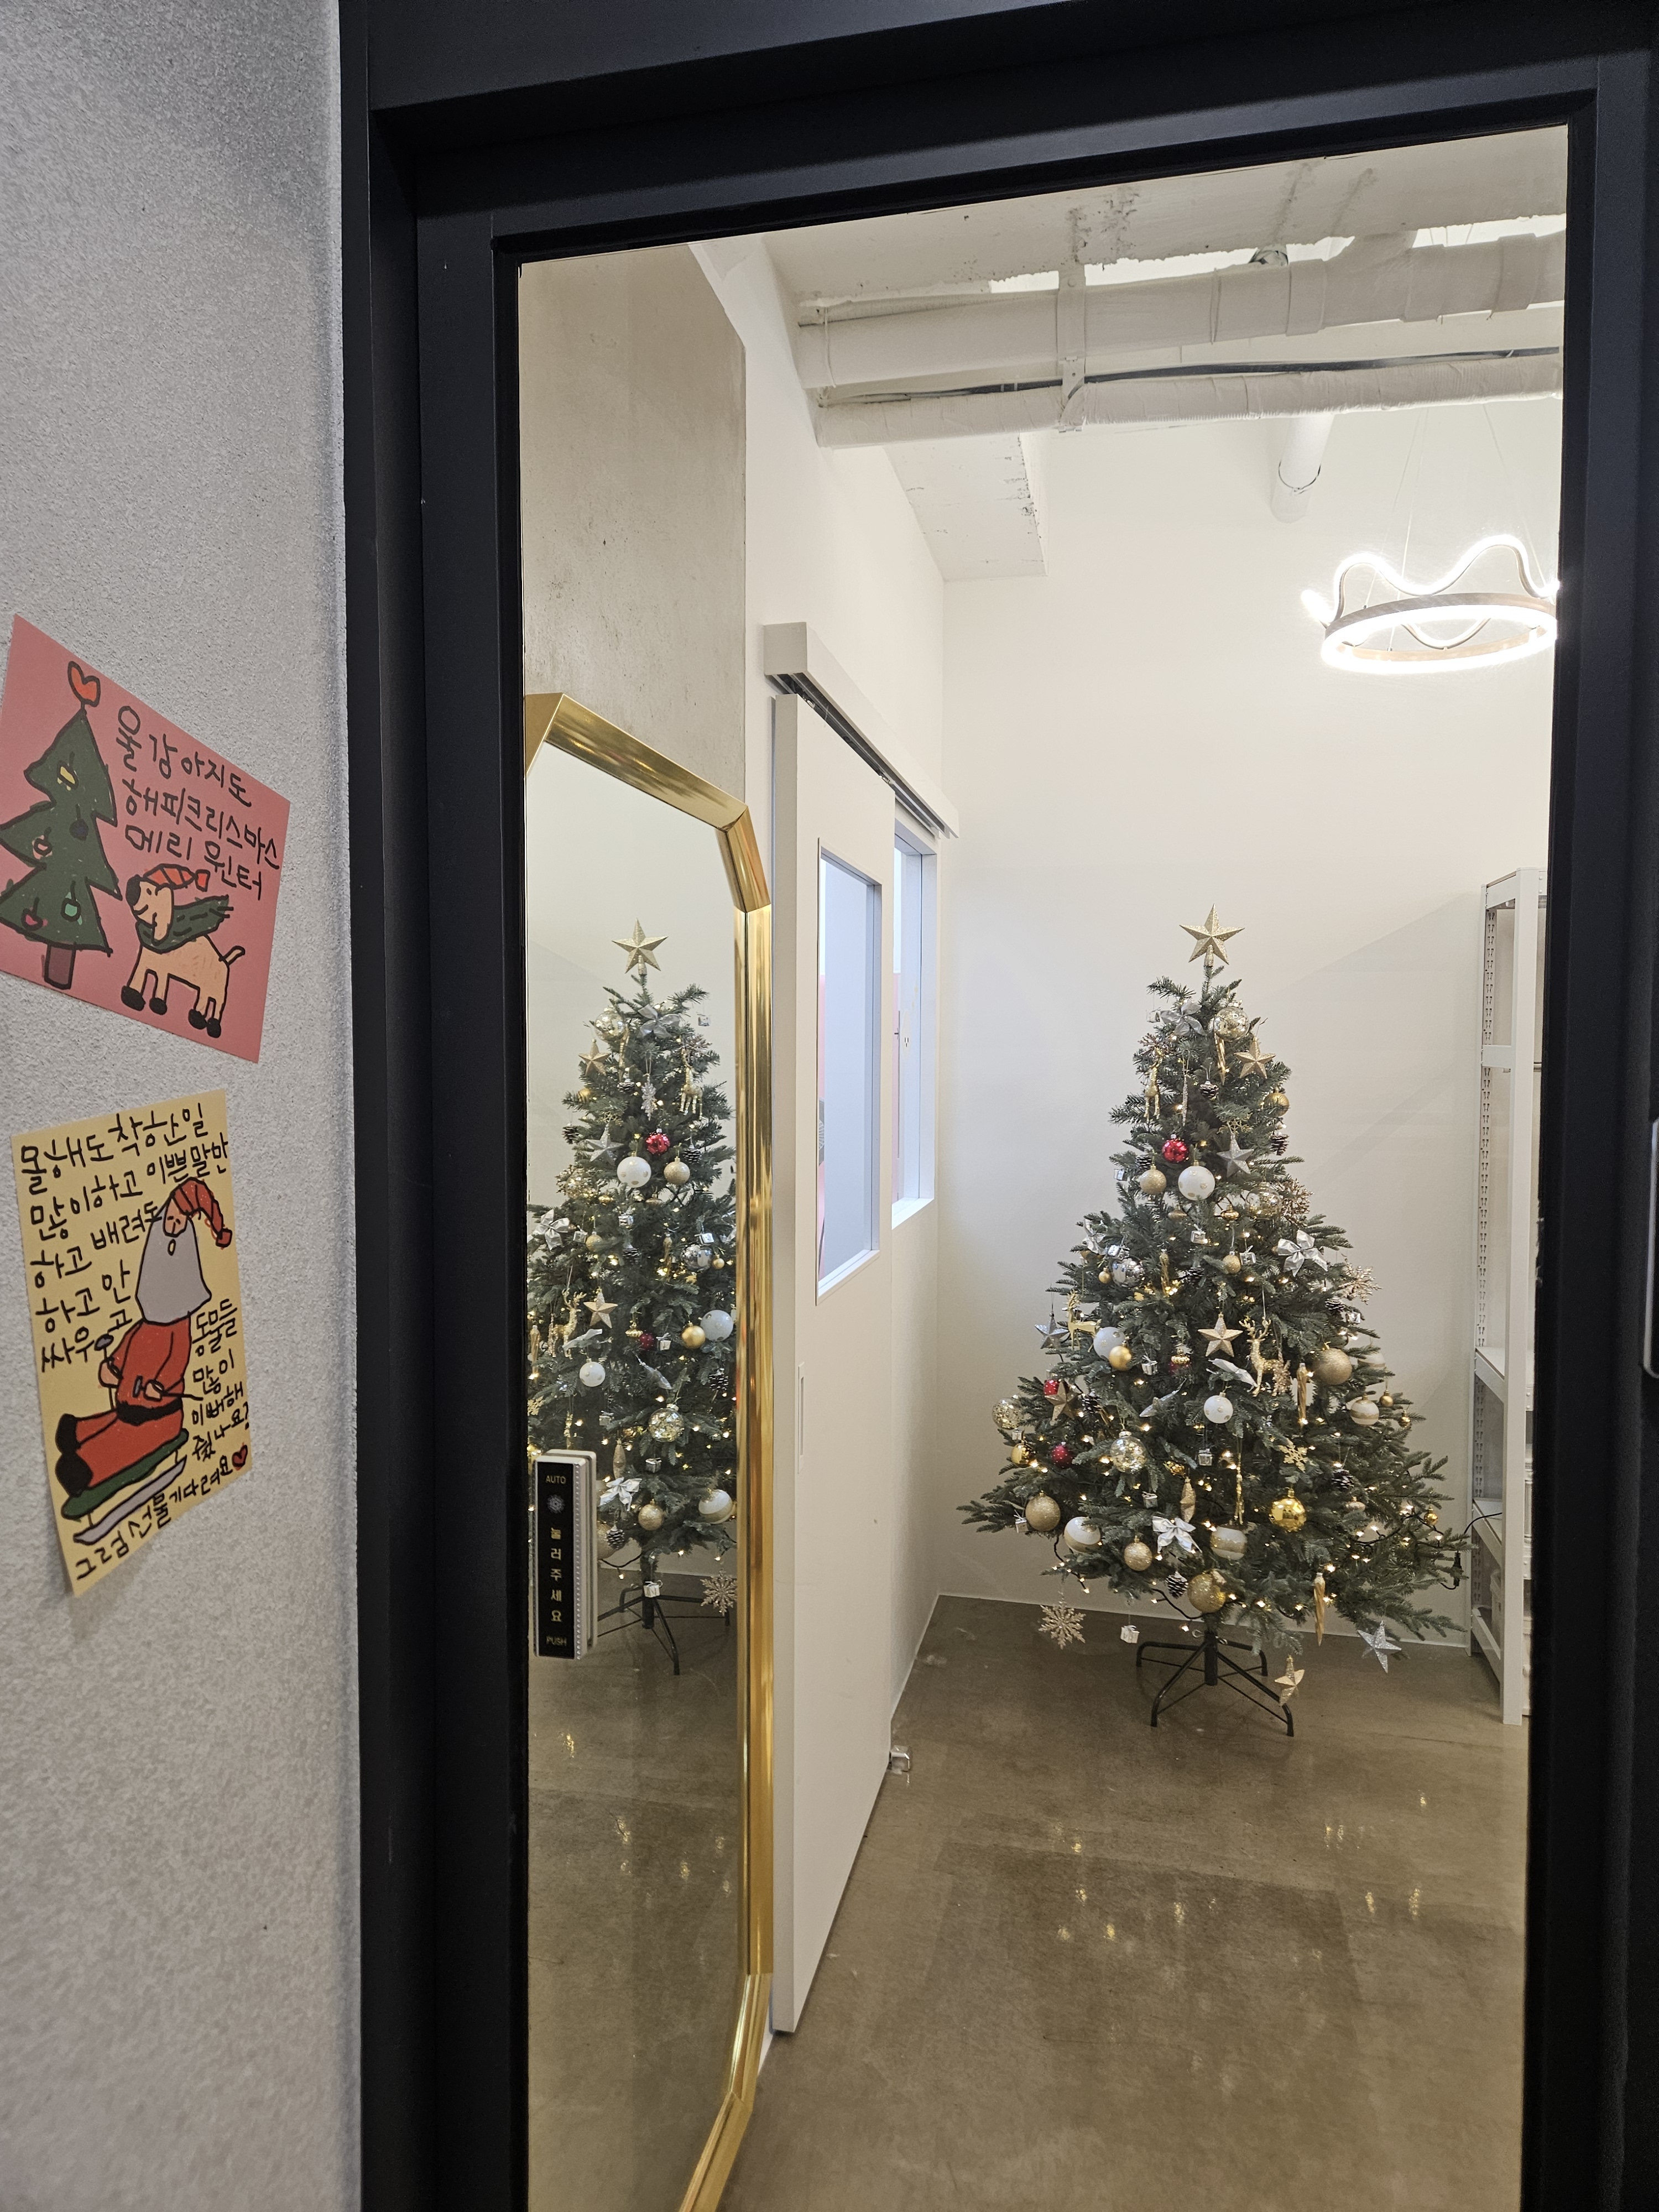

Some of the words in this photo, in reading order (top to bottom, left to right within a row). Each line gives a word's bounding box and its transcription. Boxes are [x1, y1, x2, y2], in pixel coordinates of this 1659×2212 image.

[125, 825, 192, 860] 메리
[30, 1245, 92, 1288] 하고
[90, 1201, 163, 1250] 배려도
[35, 1287, 100, 1333] 하고
[102, 1259, 132, 1304] 안
[191, 1298, 238, 1357] 동물들
[192, 1348, 234, 1395] 많이
[545, 1475, 567, 1485] AUTO
[546, 1635, 567, 1647] PUSH
